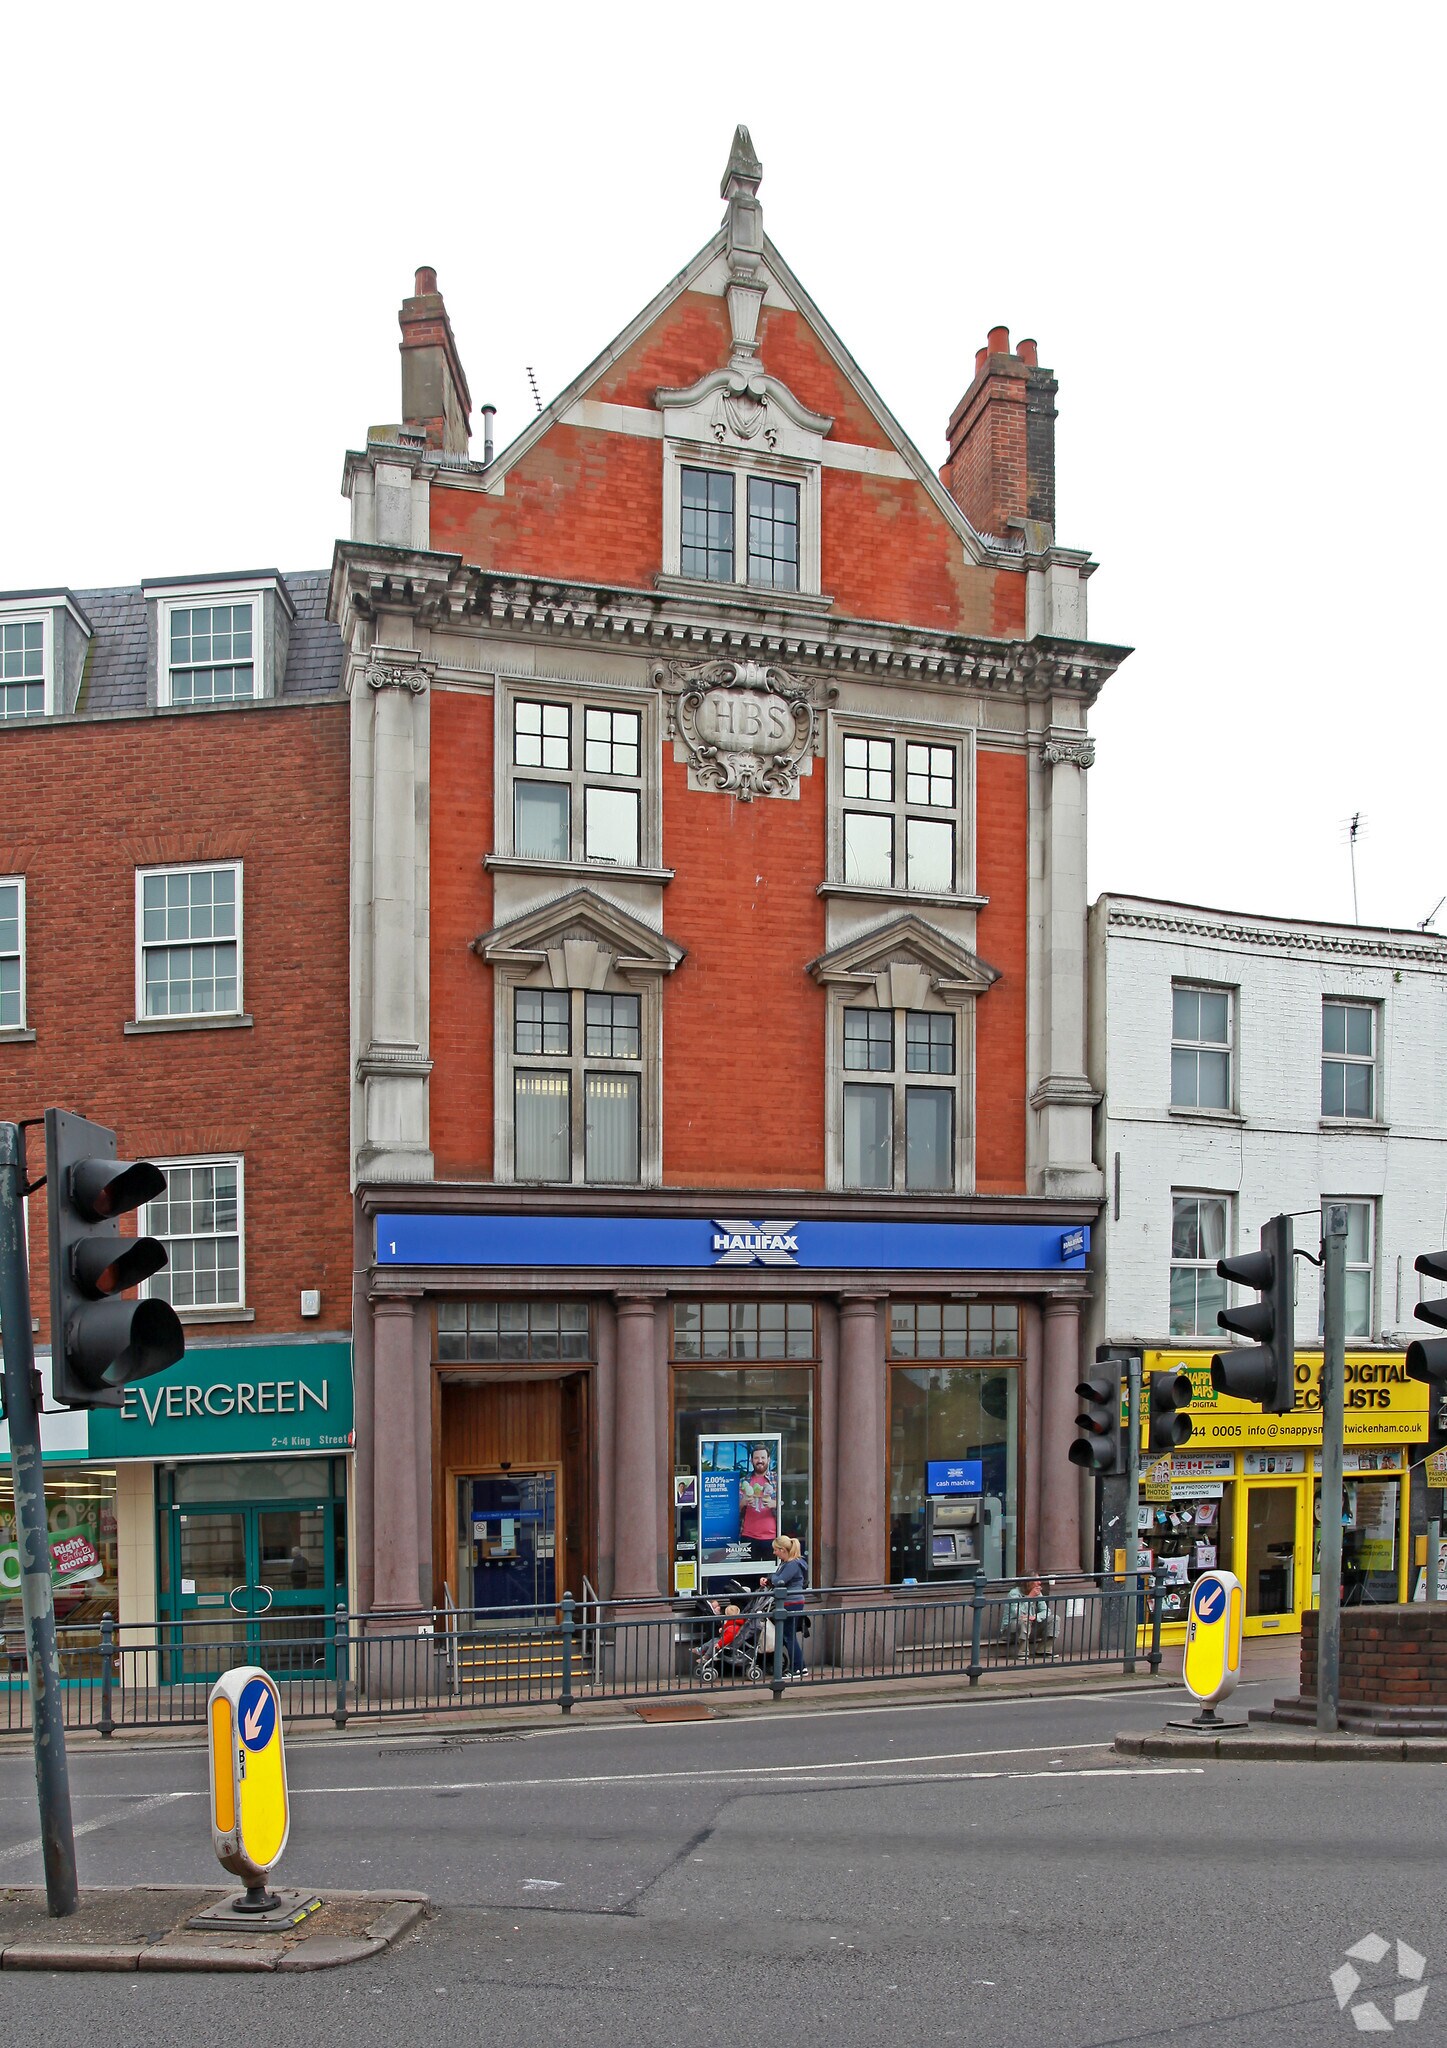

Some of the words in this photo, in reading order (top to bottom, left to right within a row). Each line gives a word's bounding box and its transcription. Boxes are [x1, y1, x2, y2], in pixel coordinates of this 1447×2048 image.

[713, 701, 785, 739] HBS
[390, 1241, 396, 1255] 1
[713, 1234, 799, 1251] HALIFAX
[121, 1380, 328, 1427] EVERGREEN
[272, 1437, 288, 1446] 2-4
[291, 1436, 310, 1446] King
[319, 1434, 348, 1445] Street
[1192, 1426, 1206, 1437] 44
[1212, 1425, 1242, 1436] 0005
[53, 1538, 85, 1557] Right
[60, 1552, 95, 1571] money
